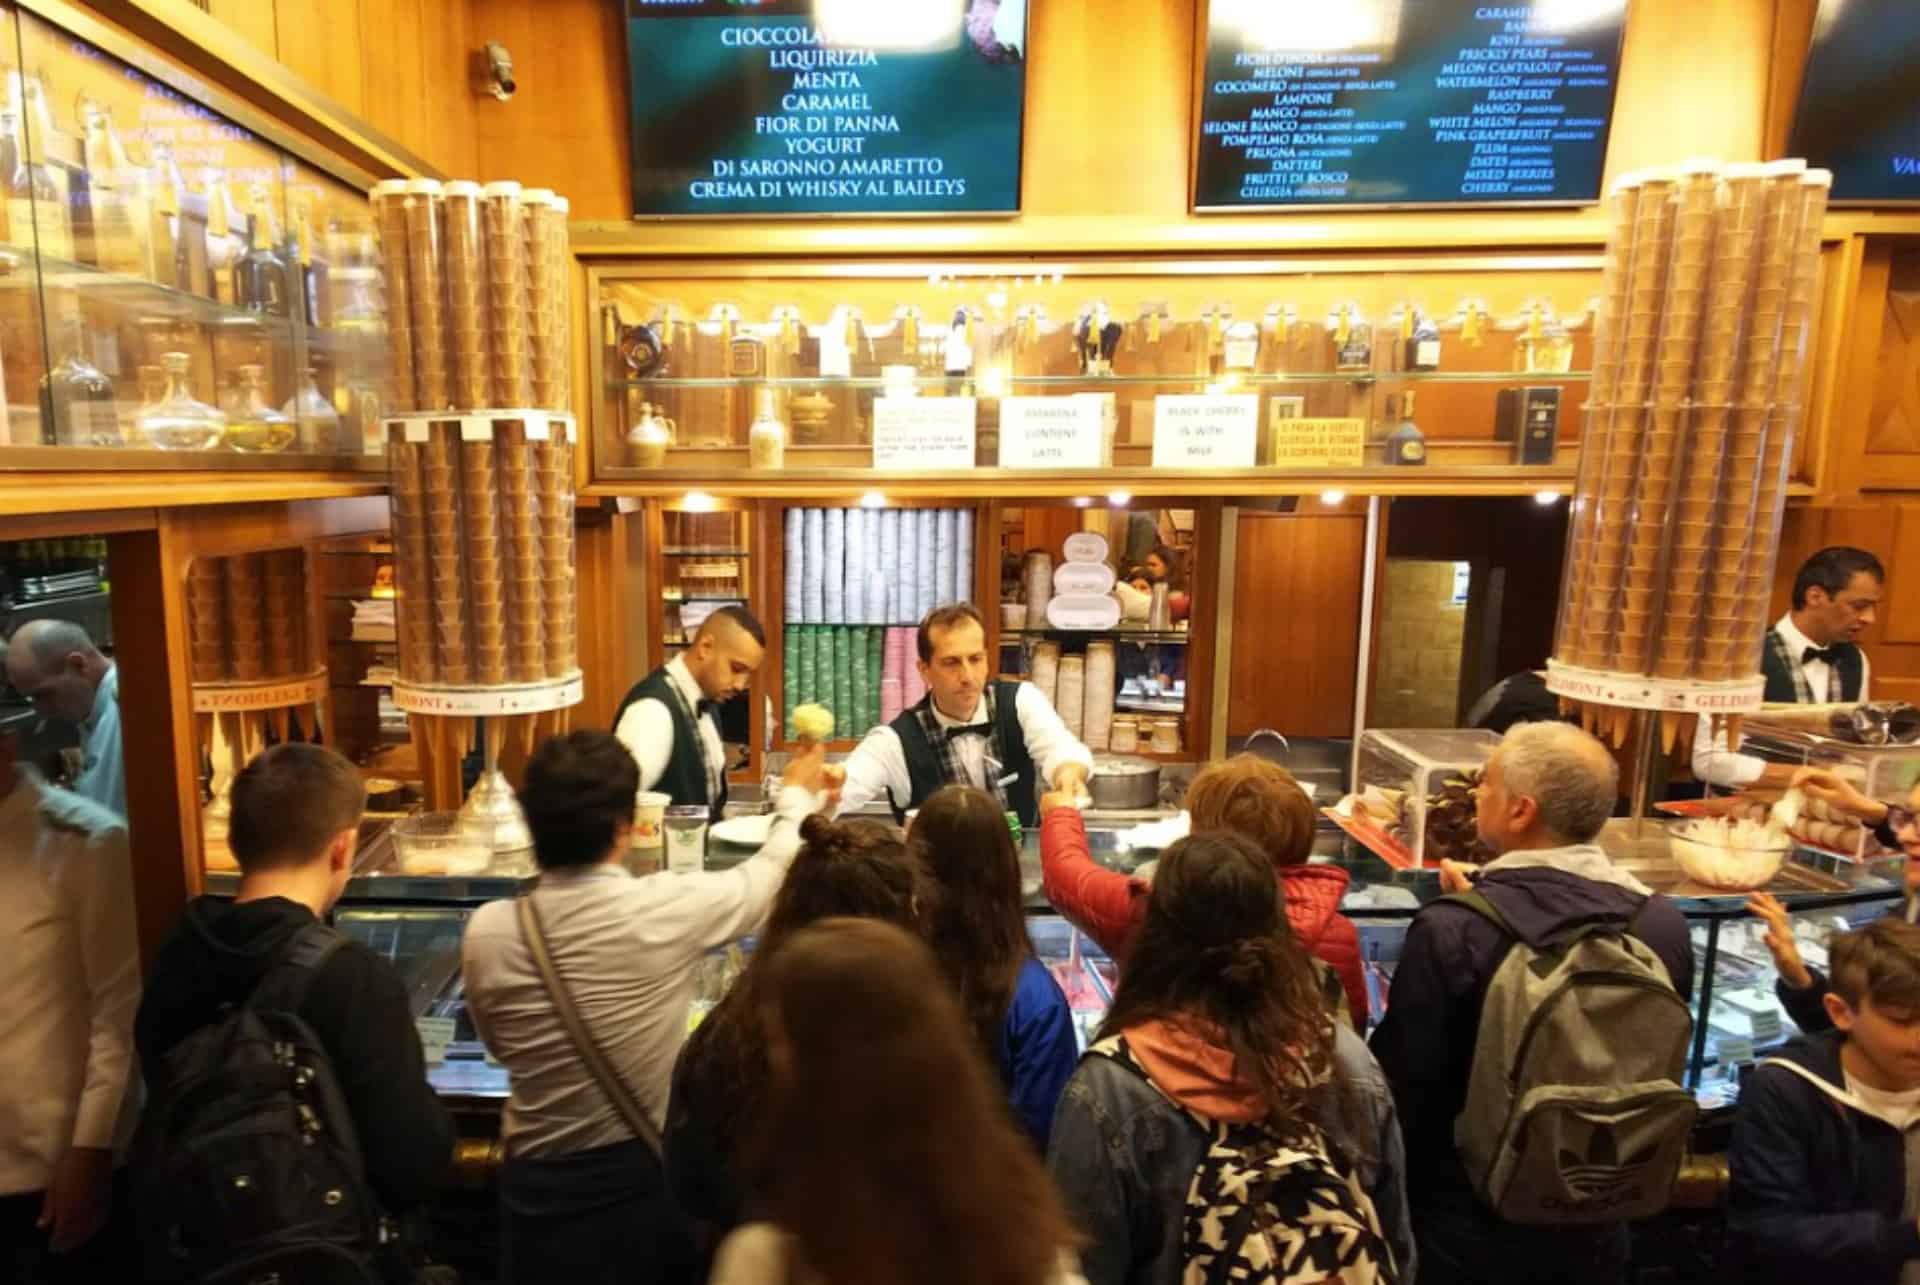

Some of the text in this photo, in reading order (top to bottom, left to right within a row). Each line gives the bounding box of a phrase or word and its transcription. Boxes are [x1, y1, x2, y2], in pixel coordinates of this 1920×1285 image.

[770, 50, 878, 69] LIQUIRIZIA
[1458, 49, 1511, 61] PRICKLY
[1513, 48, 1549, 60] PEARS
[1253, 66, 1304, 78] MELONE
[1441, 63, 1487, 74] MELON
[793, 73, 861, 89] MENTA
[1214, 80, 1287, 93] COCOMERO
[1434, 76, 1521, 88] WATERMELON
[1274, 93, 1334, 105] LAMPONE
[1488, 89, 1555, 101] RASPBERRY
[781, 94, 872, 111] CARAMEL
[1472, 103, 1522, 114] MANGO
[1251, 107, 1299, 119] MANGO
[755, 115, 899, 133] FIOR DI PANNA
[1250, 120, 1298, 132] BIANCO
[1429, 117, 1470, 128] WHITE
[1473, 116, 1517, 127] MELON
[1221, 134, 1290, 146] POMPELMO
[1292, 133, 1324, 145] ROSA
[1435, 130, 1465, 142] PINK
[785, 137, 865, 155] YOGURT
[1474, 143, 1507, 154] PLUM
[1245, 147, 1295, 159] PRUGNA
[713, 158, 943, 177] DI SARONNO AMARETTO
[1272, 160, 1323, 171] DATTERI
[1470, 156, 1508, 167] DATES
[1245, 172, 1349, 185] FRUTTI DI BOSCO
[1464, 168, 1555, 180] MIXED BERRIES
[690, 178, 966, 198] CREMA DI WHISKY AL BAILEYS
[1240, 186, 1291, 198] CILIEGIA
[1461, 182, 1511, 194] CHERRY
